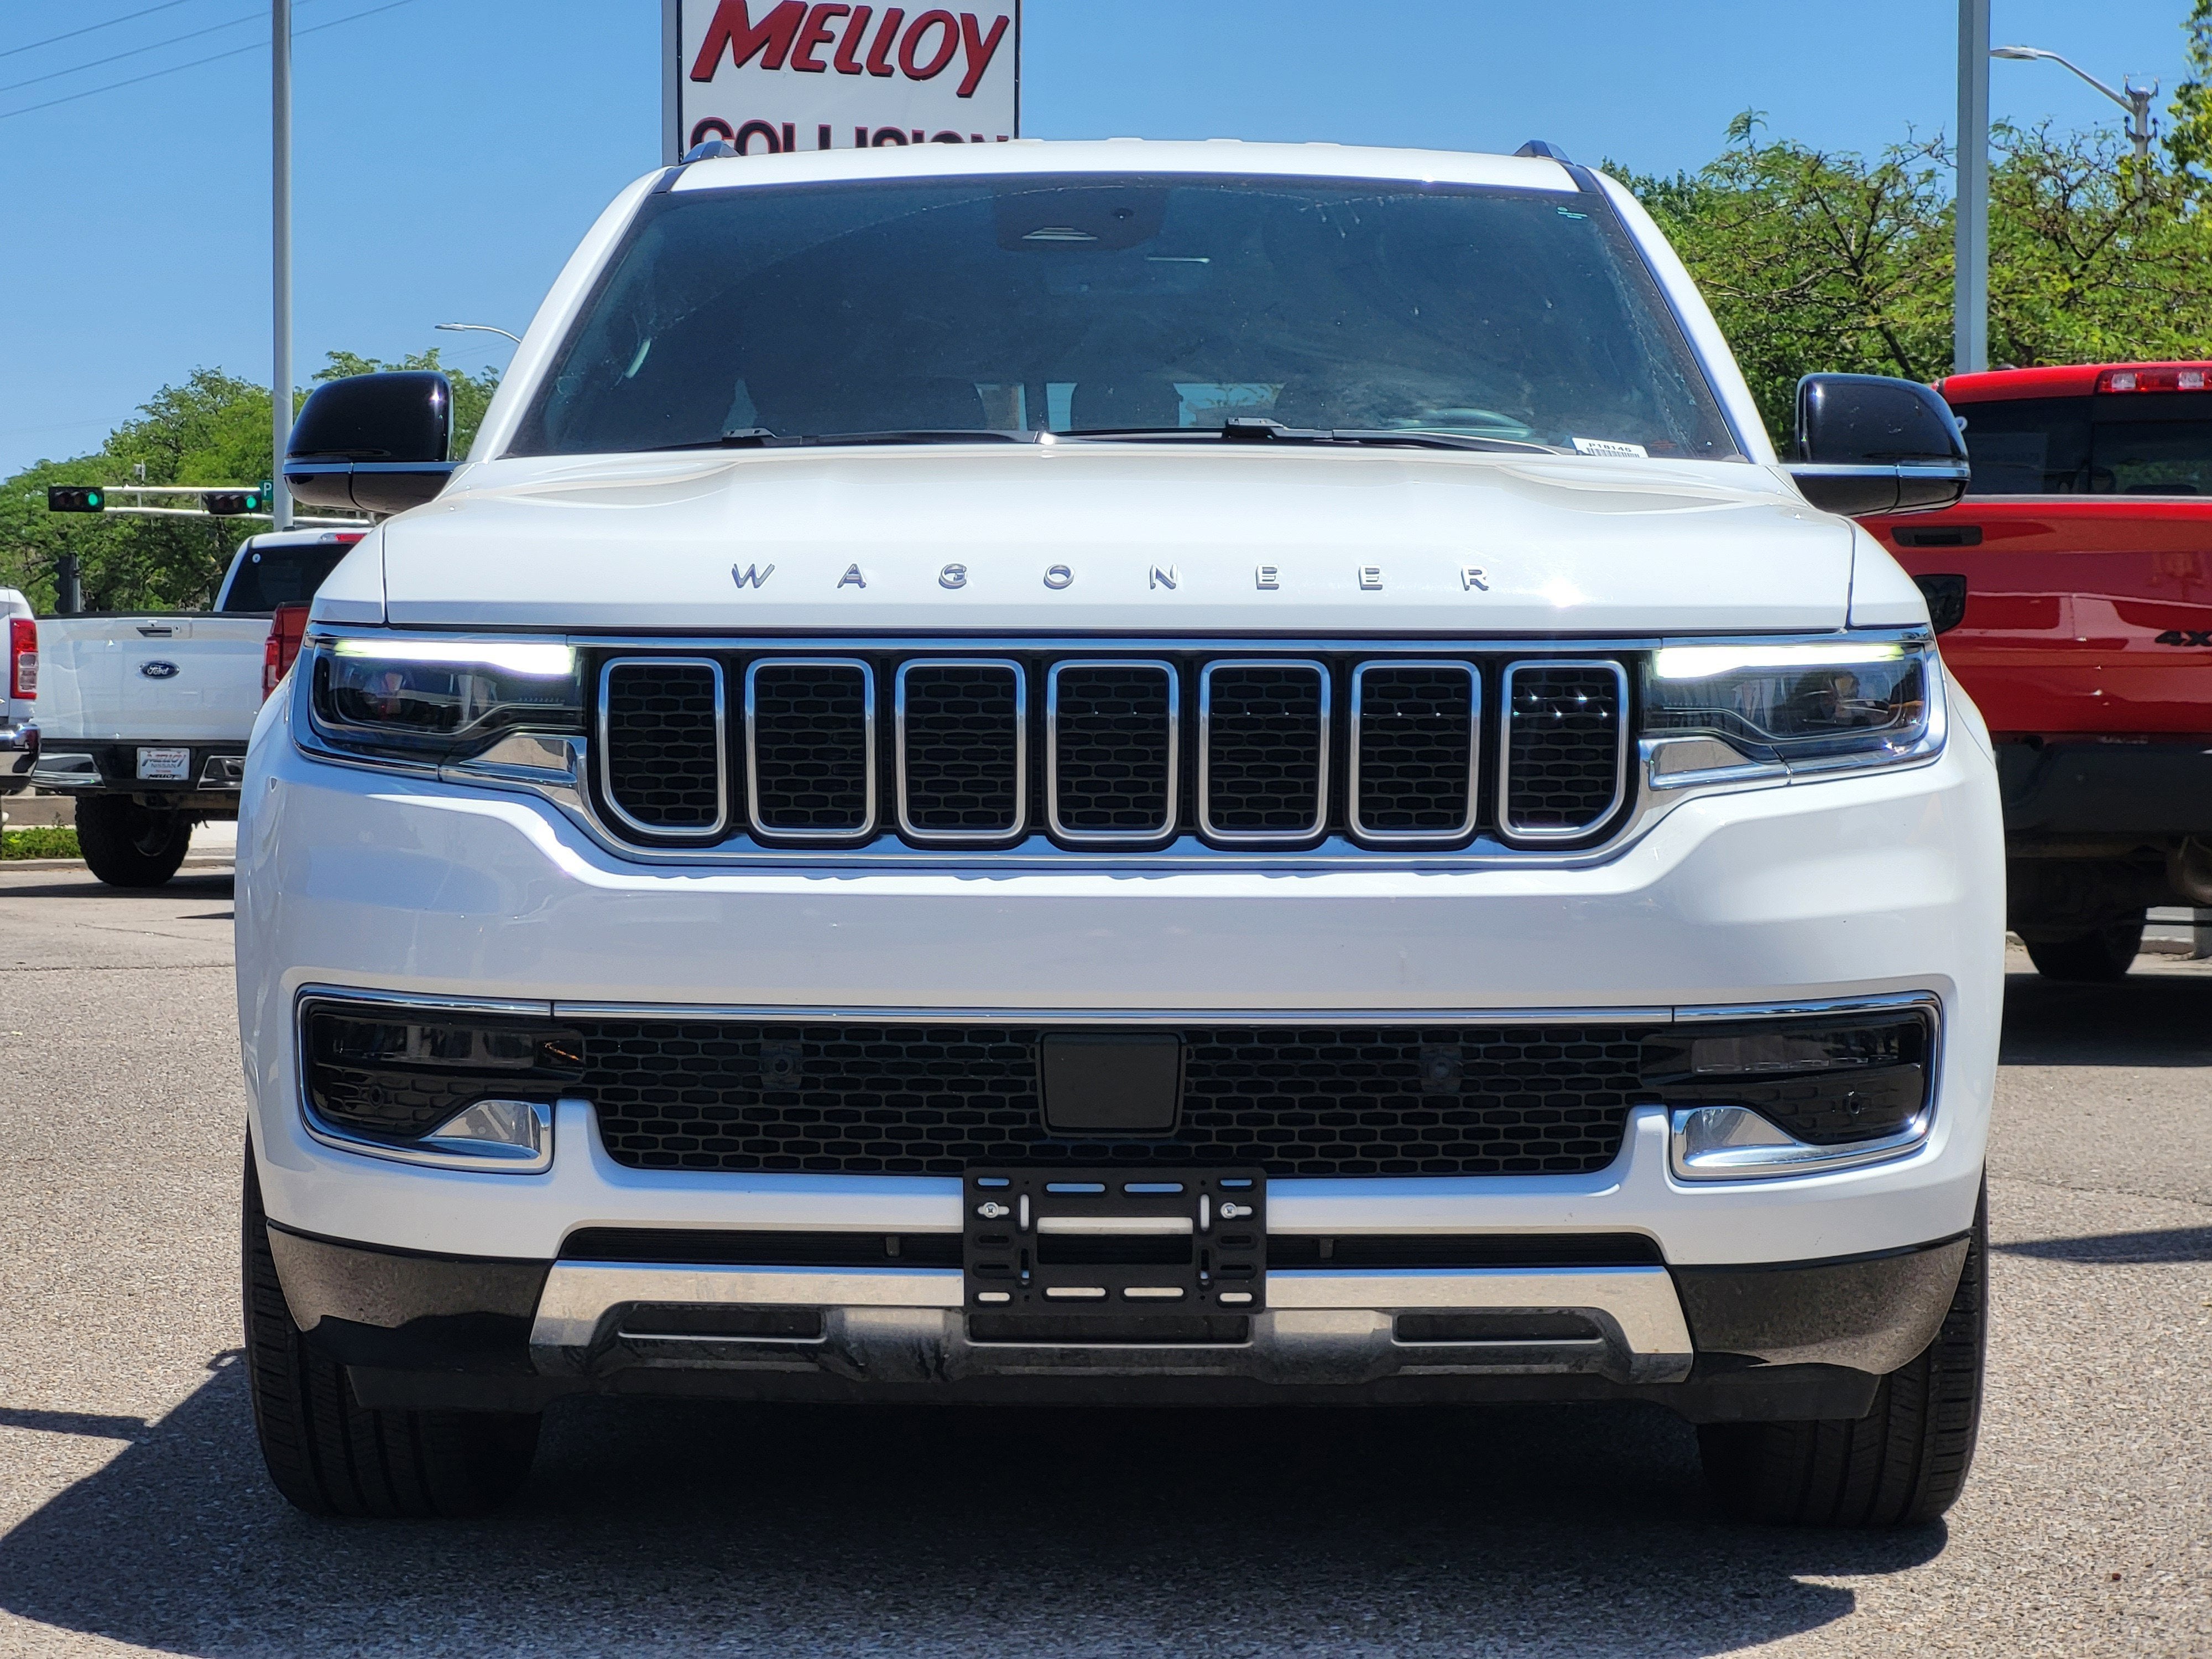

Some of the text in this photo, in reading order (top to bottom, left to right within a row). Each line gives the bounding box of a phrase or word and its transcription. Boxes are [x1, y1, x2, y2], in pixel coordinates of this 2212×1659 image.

[690, 0, 1010, 98] MELLOY
[732, 563, 1489, 591] WAGONEER
[147, 665, 169, 675] Ford
